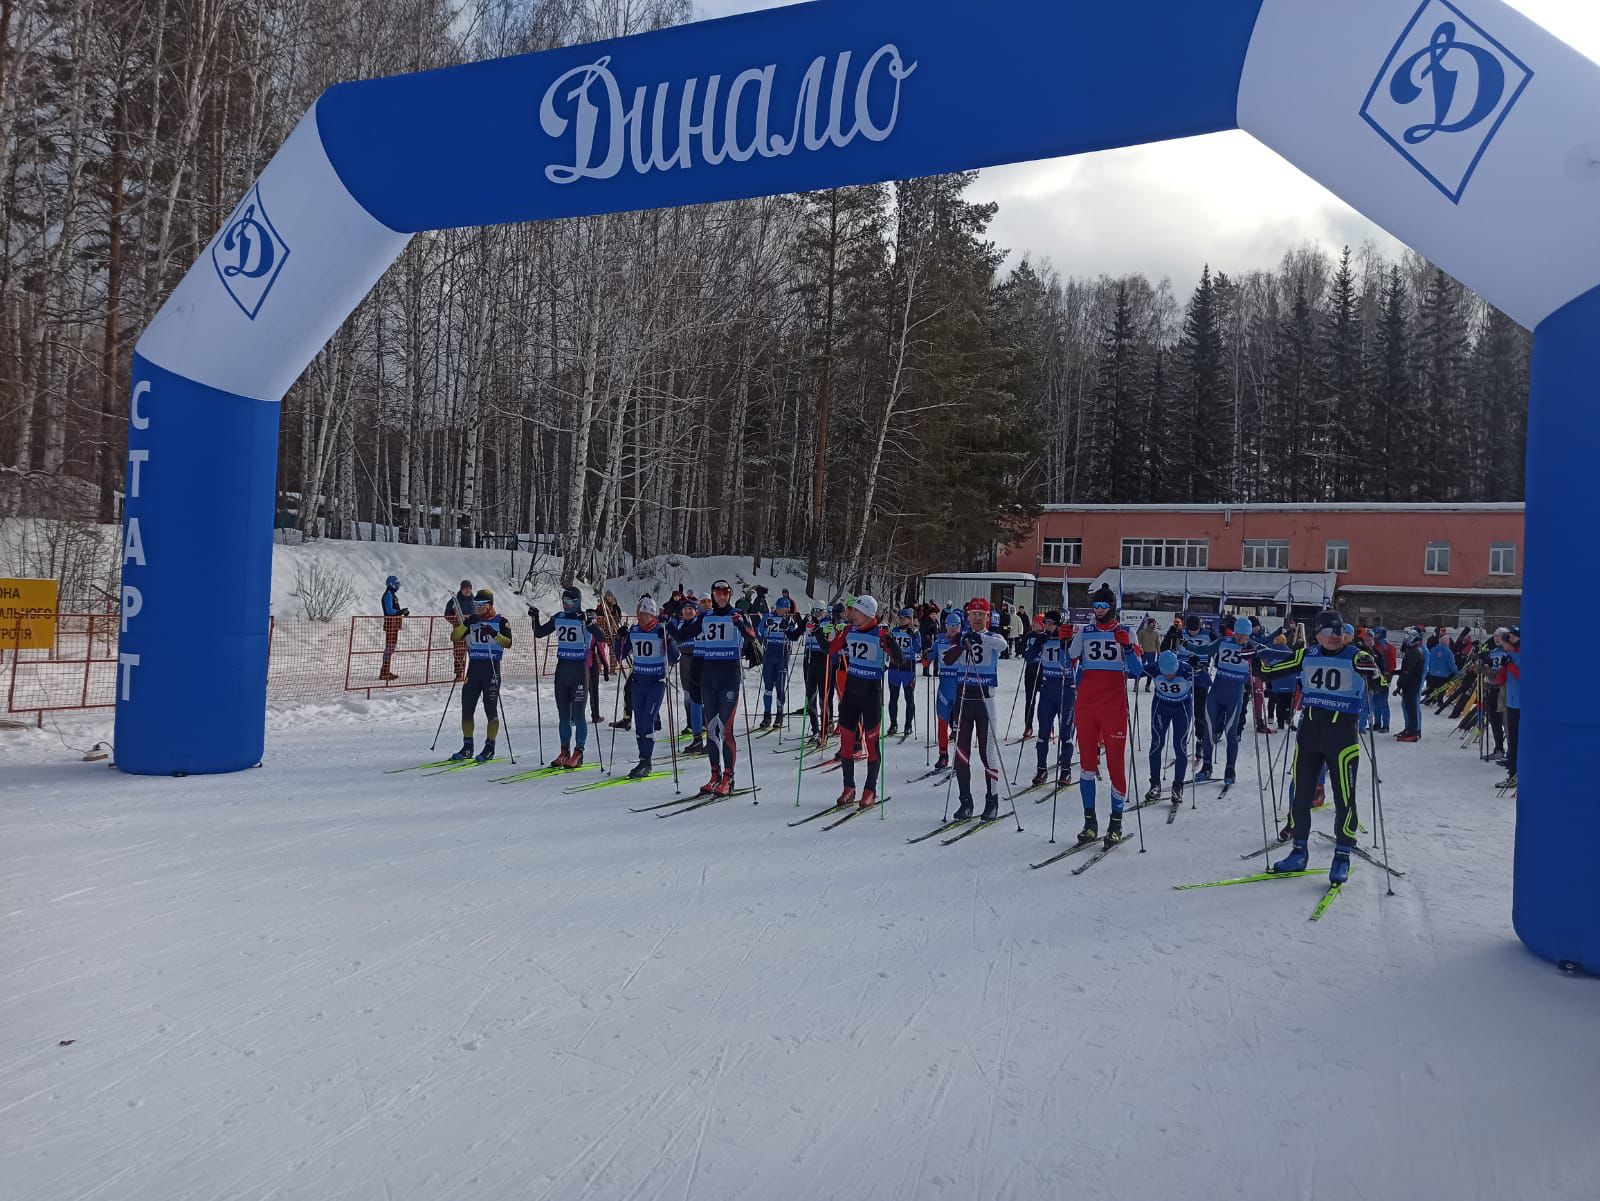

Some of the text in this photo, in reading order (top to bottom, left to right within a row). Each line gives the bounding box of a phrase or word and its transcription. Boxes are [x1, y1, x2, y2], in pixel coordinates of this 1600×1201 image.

[539, 43, 918, 184] Динамо
[119, 380, 151, 701] СТАРТ
[558, 626, 577, 642] 26
[707, 623, 725, 639] 31
[635, 640, 653, 657] 10
[850, 643, 868, 660] 12
[1088, 640, 1118, 661] 35
[1220, 649, 1242, 664] 25
[1159, 682, 1181, 693] 38
[1310, 667, 1341, 691] 40
